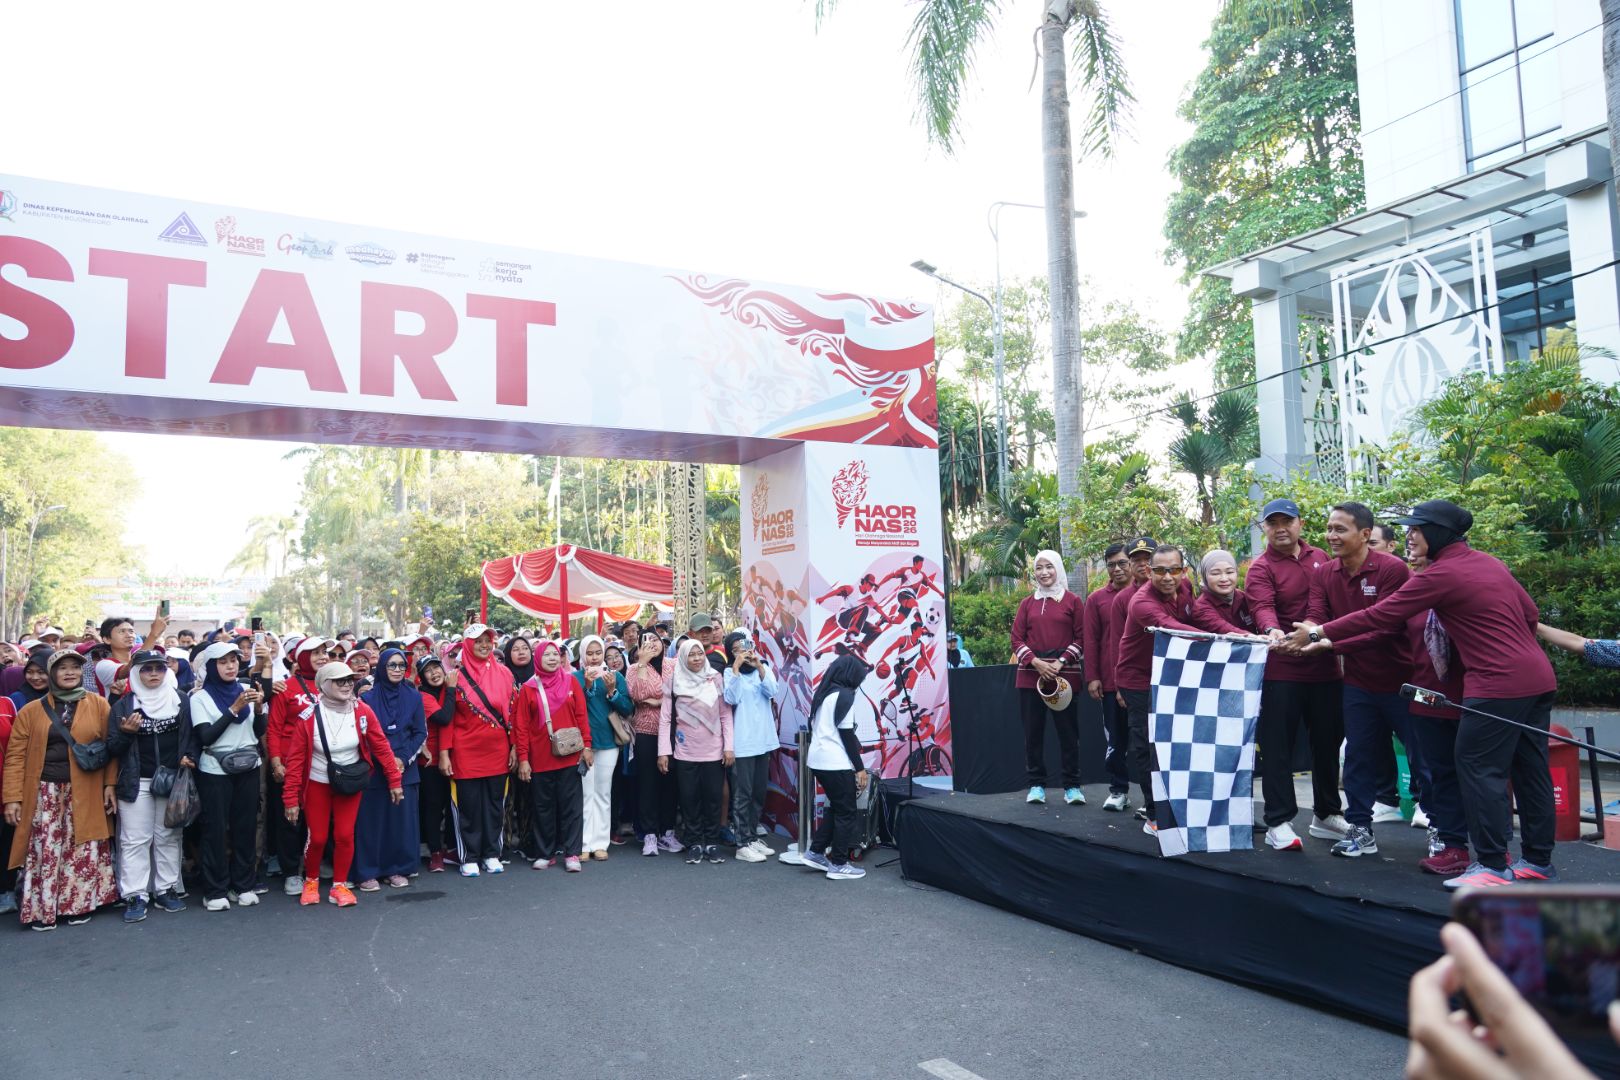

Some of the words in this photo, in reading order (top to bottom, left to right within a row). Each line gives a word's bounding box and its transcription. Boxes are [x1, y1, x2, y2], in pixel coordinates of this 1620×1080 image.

[22, 202, 45, 211] DINAS
[46, 206, 95, 217] KEPEMUDAAN
[96, 211, 111, 219] DAN
[112, 214, 149, 225] OLAHRAGA
[22, 210, 64, 221] KABUPATEN
[227, 234, 265, 245] HAOR
[227, 240, 256, 250] NAS
[495, 260, 532, 271] semangat
[495, 267, 518, 276] kerja
[495, 274, 523, 284] nyata
[0, 234, 557, 407] START
[854, 504, 917, 519] HAOR
[762, 509, 794, 528] HAOR
[903, 519, 917, 527] 20
[854, 518, 902, 533] NAS
[903, 526, 918, 534] 26
[762, 524, 786, 543] NAS
